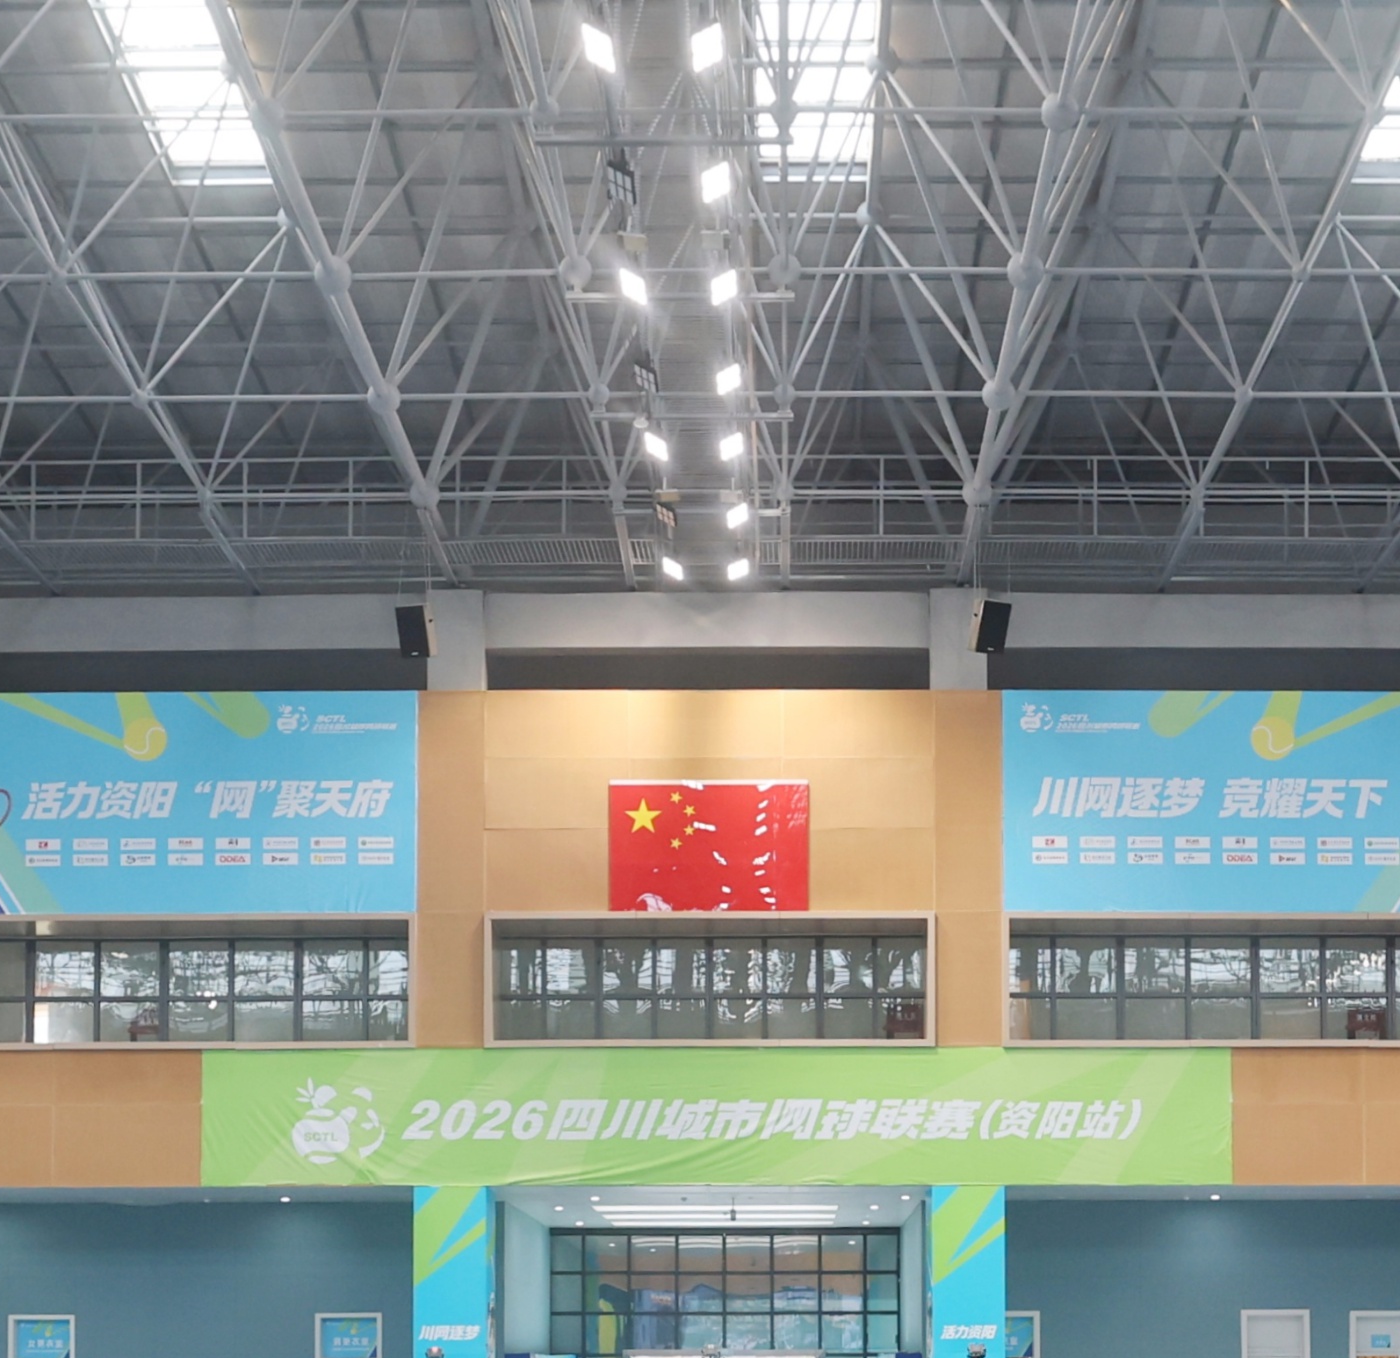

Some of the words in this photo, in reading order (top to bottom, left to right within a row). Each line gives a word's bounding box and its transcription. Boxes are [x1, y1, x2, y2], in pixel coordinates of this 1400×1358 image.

[21, 781, 177, 820] 活力资阳
[194, 780, 393, 819] “网”聚天府
[1032, 777, 1204, 818] 川网逐梦
[1218, 779, 1388, 819] 竞耀天下
[303, 1131, 338, 1142] SCTL
[418, 1325, 480, 1340] 川网逐梦
[940, 1325, 997, 1340] 活力资阳
